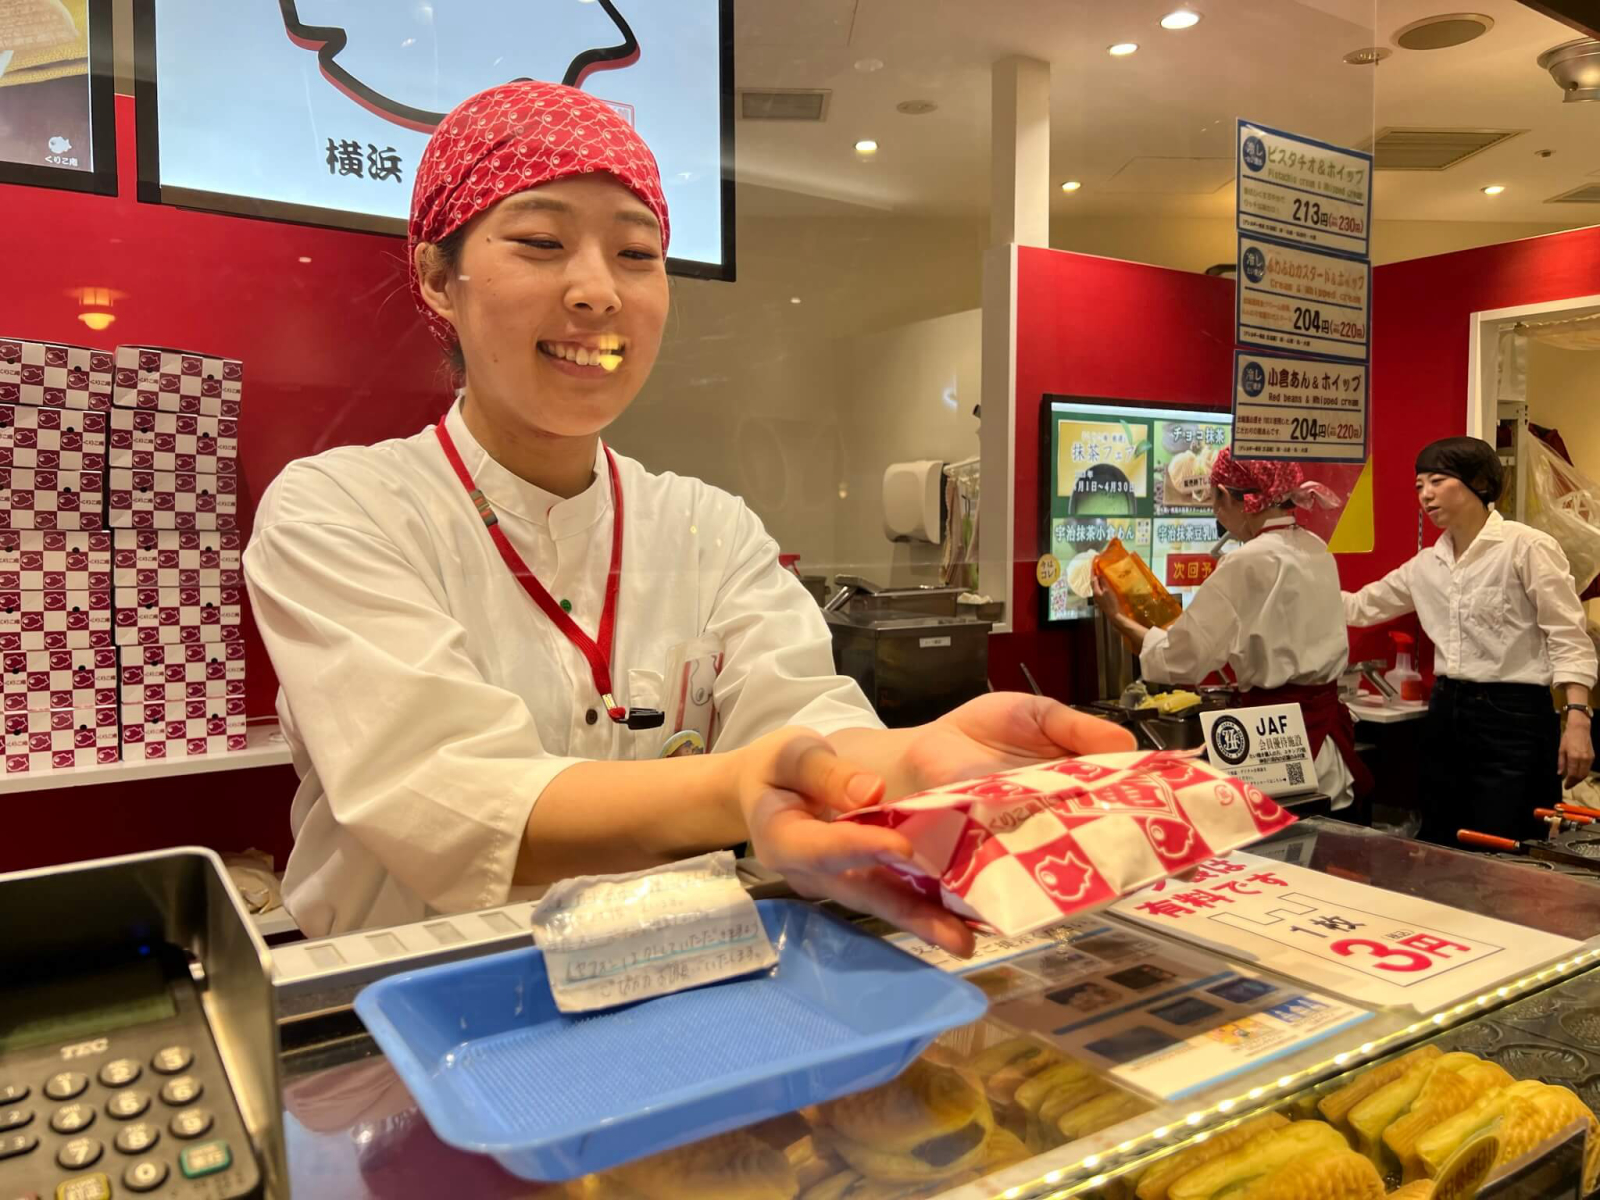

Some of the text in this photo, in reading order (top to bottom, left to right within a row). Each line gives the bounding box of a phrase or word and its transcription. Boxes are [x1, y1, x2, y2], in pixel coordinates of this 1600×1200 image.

[326, 138, 403, 183] 横浜
[1172, 426, 1225, 444] チョコ抹茶
[1072, 443, 1136, 463] 抹茶フェア
[1256, 715, 1287, 736] JAF
[1134, 872, 1288, 918] 有料です
[1290, 914, 1366, 939] 1枚
[1330, 932, 1472, 973] 3円
